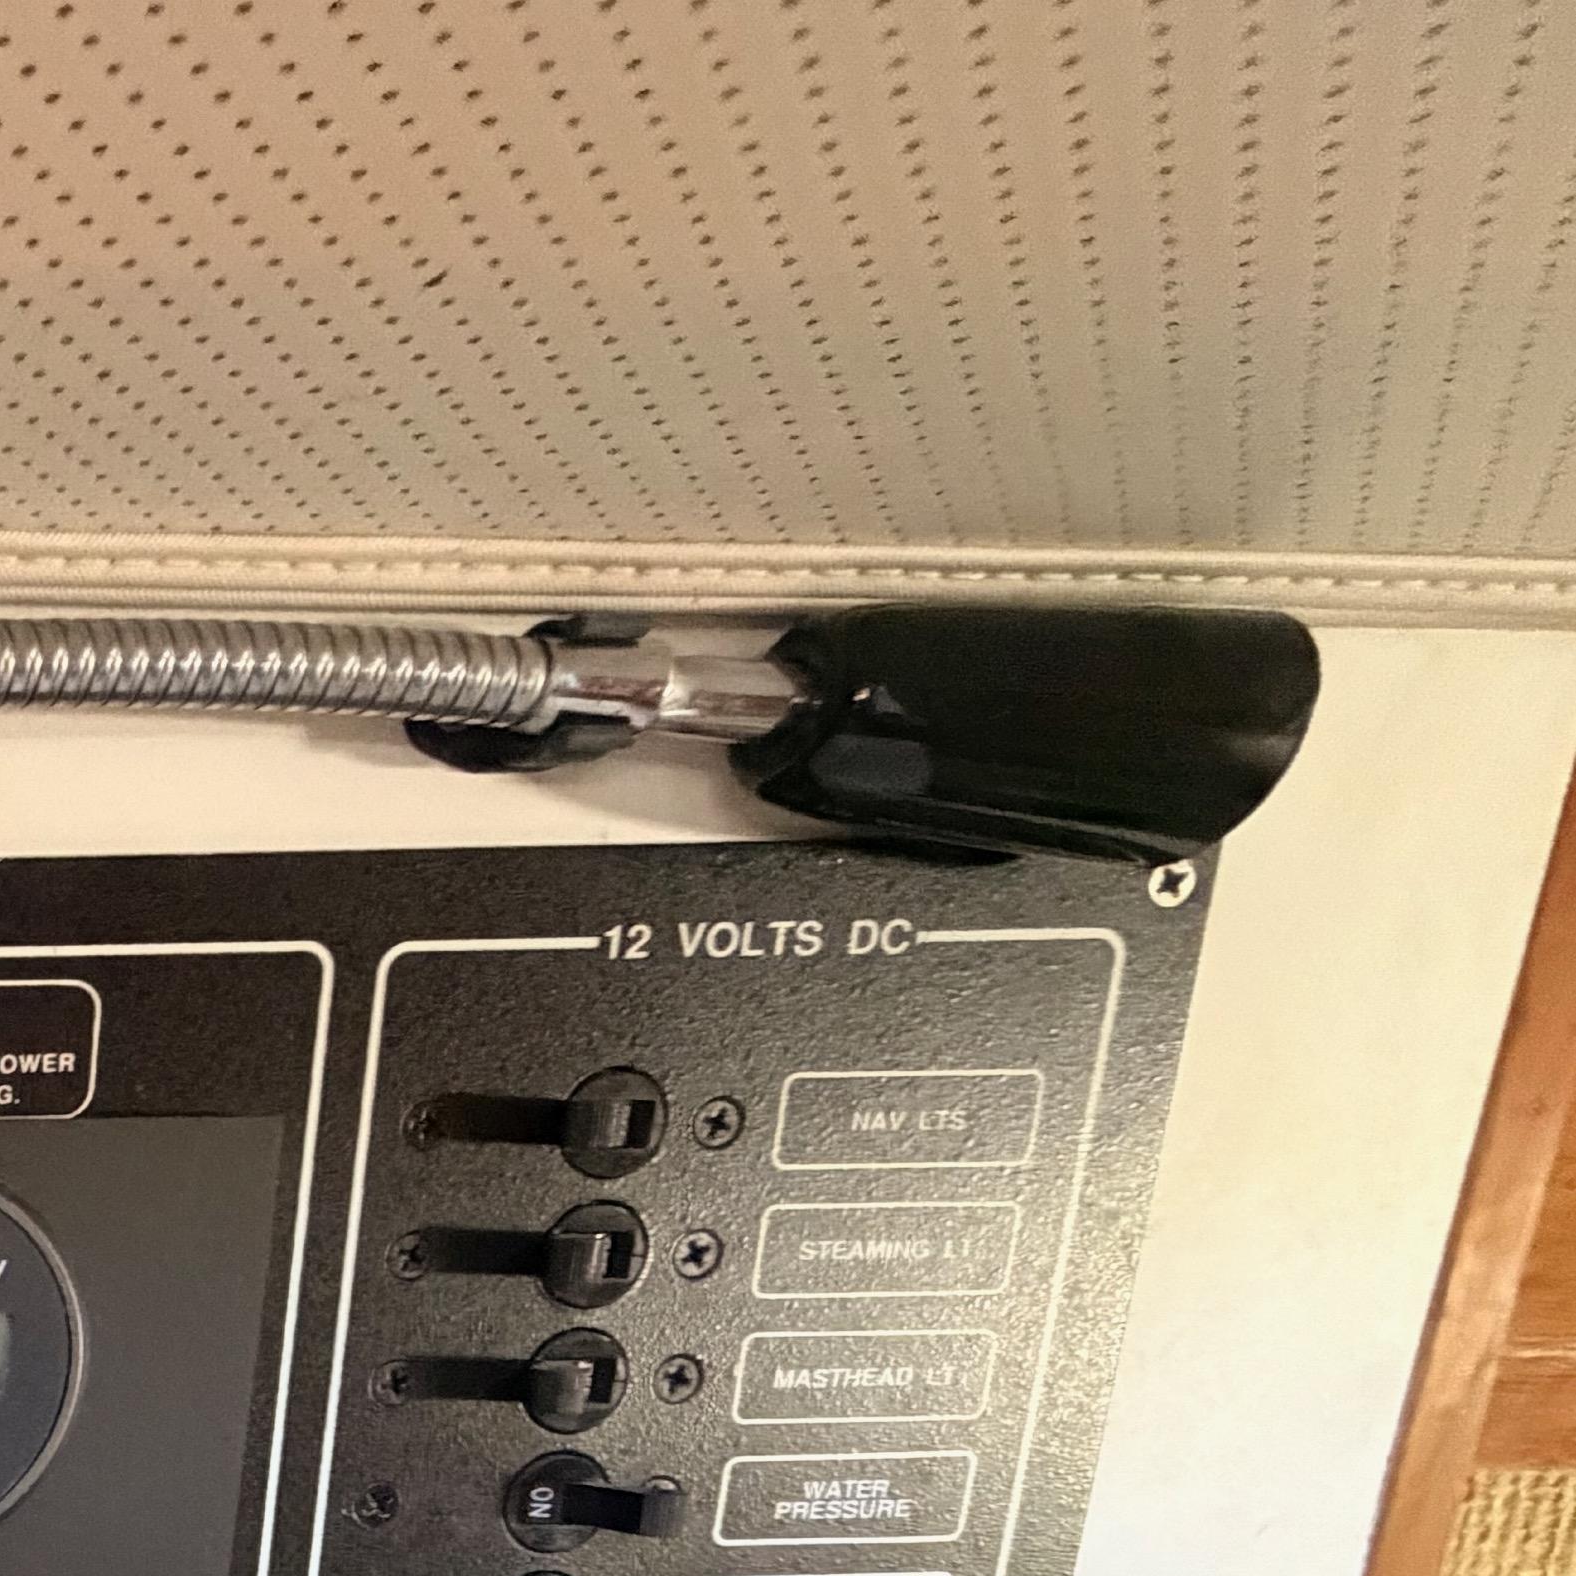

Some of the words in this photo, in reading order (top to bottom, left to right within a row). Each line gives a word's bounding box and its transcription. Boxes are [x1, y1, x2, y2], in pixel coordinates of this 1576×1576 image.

[604, 924, 652, 960] 12
[678, 920, 824, 958] VOLTS
[846, 918, 913, 955] DC
[851, 1110, 907, 1131] NAV
[799, 1239, 930, 1261] STEAMING
[773, 1366, 913, 1389] MASTHEAD
[803, 1479, 890, 1499] WATER
[774, 1498, 913, 1521] PRESSURE
